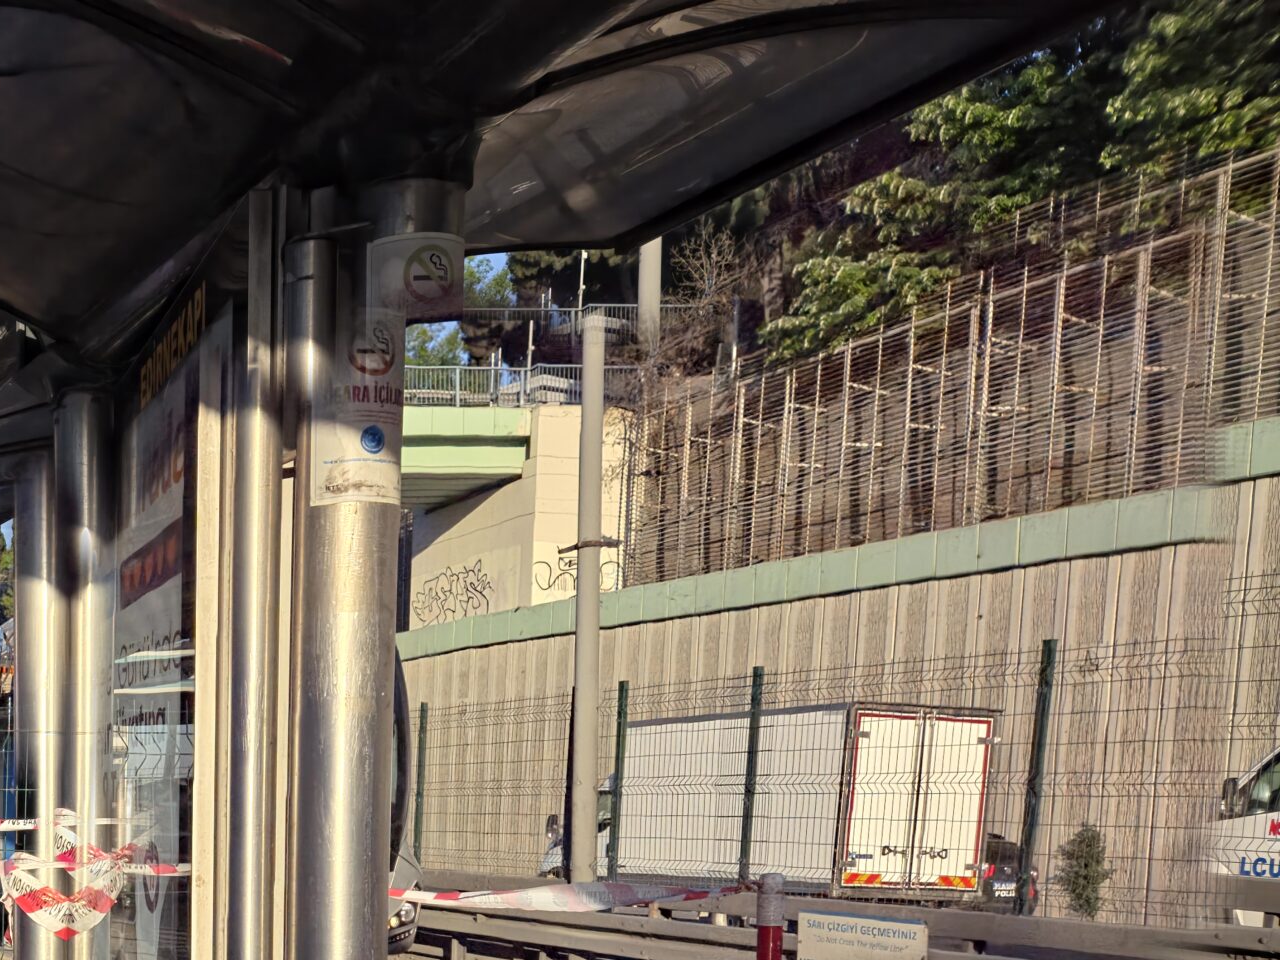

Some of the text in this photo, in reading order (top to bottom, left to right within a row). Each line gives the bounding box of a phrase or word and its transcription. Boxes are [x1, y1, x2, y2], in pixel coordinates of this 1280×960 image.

[806, 919, 918, 940] SARI ÇİZGİYİ GEÇMEYİNİZ
